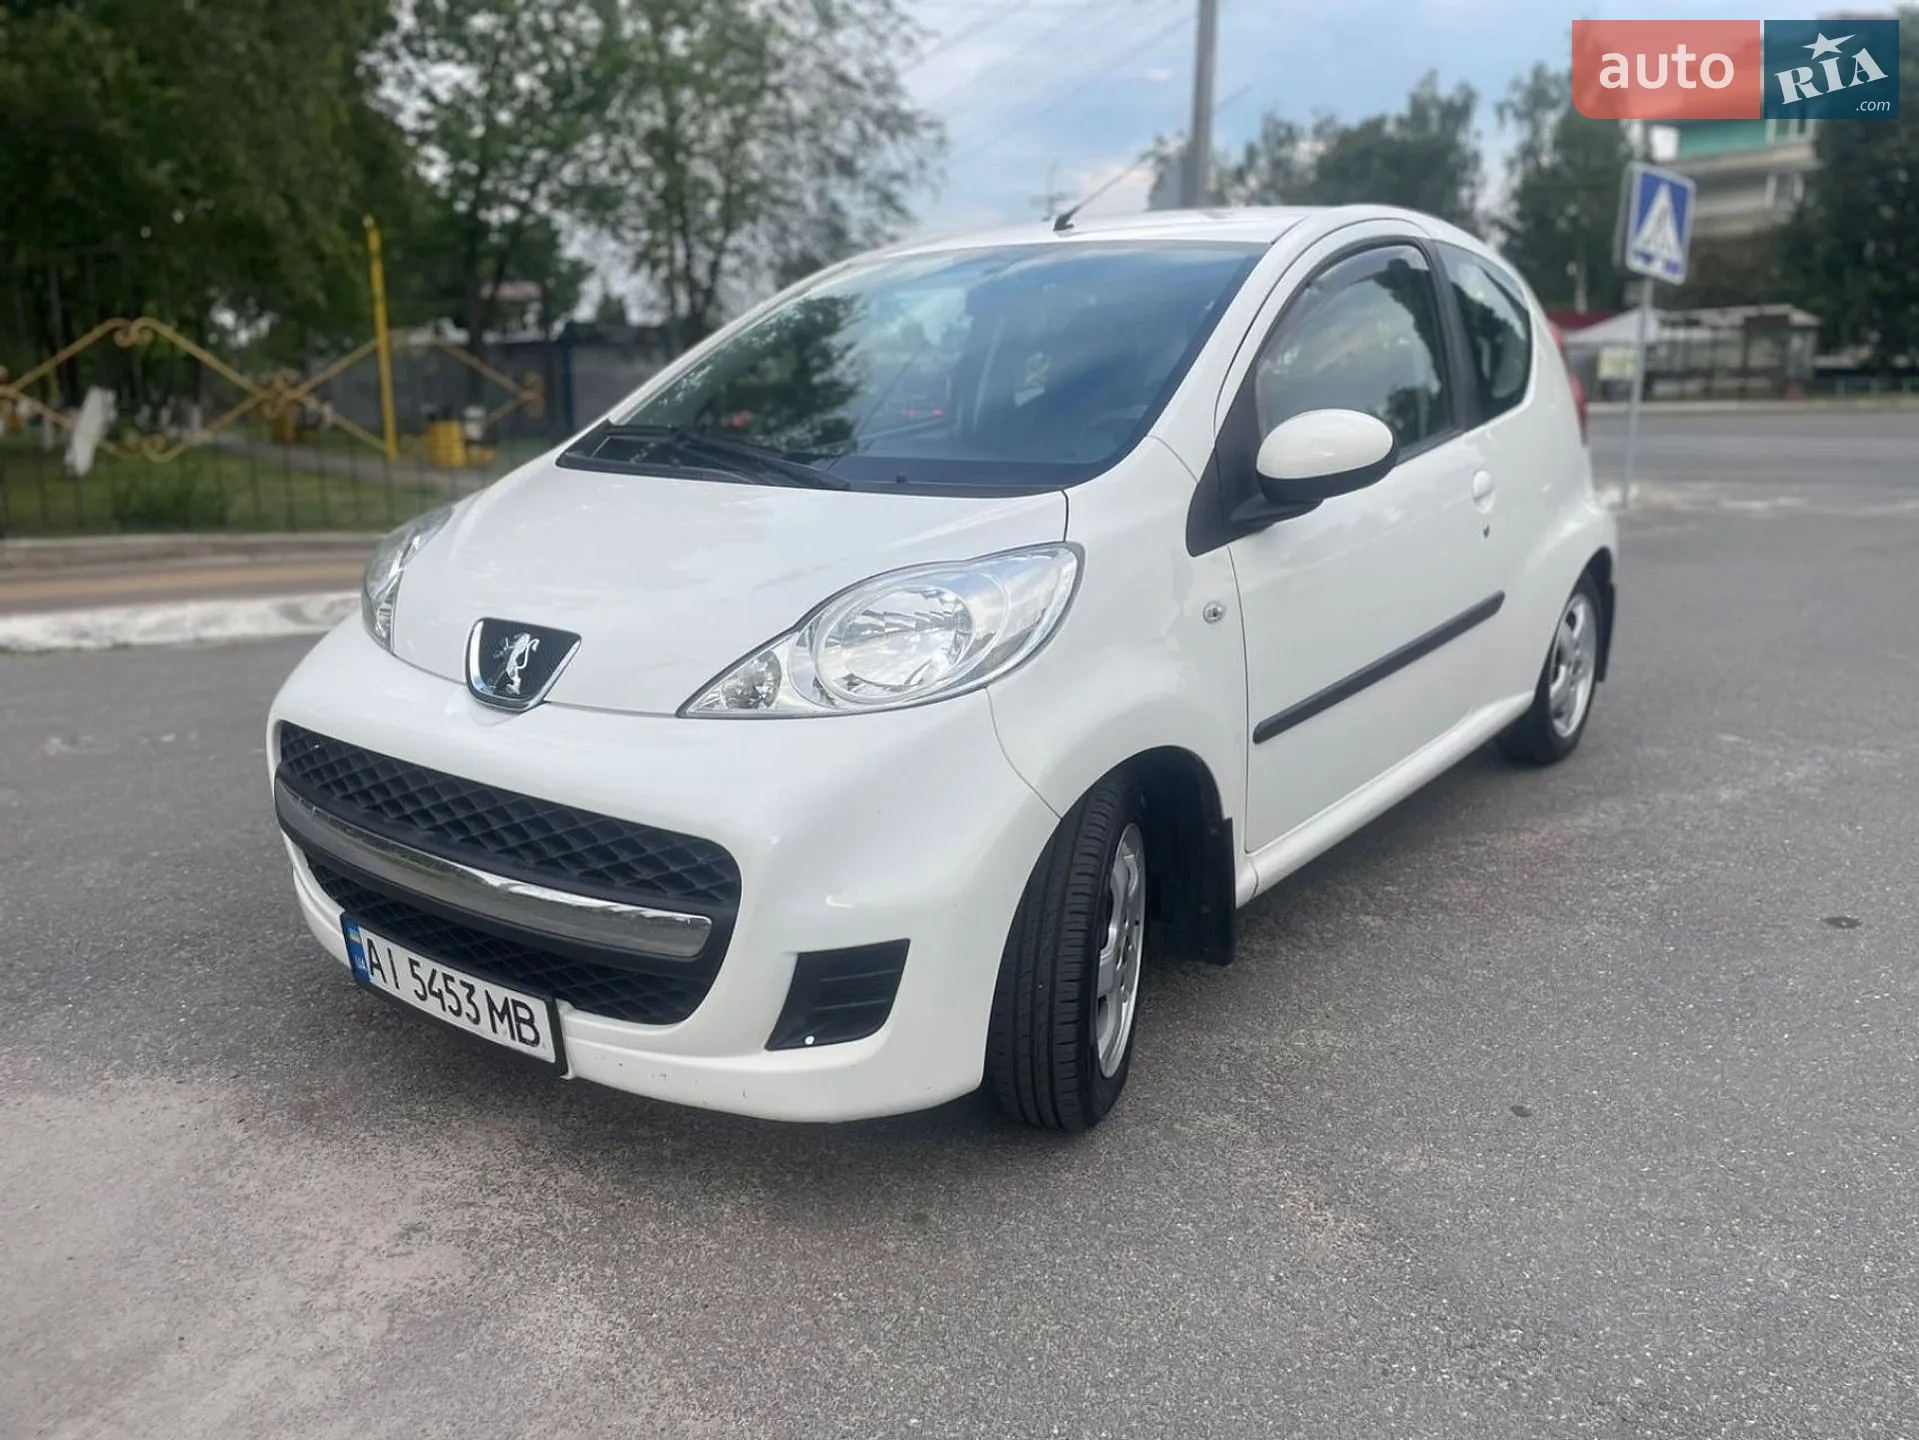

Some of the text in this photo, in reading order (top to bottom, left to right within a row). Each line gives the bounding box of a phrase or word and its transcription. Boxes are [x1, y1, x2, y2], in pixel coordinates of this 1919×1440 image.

[367, 938, 541, 1047] AI 5453 MB
